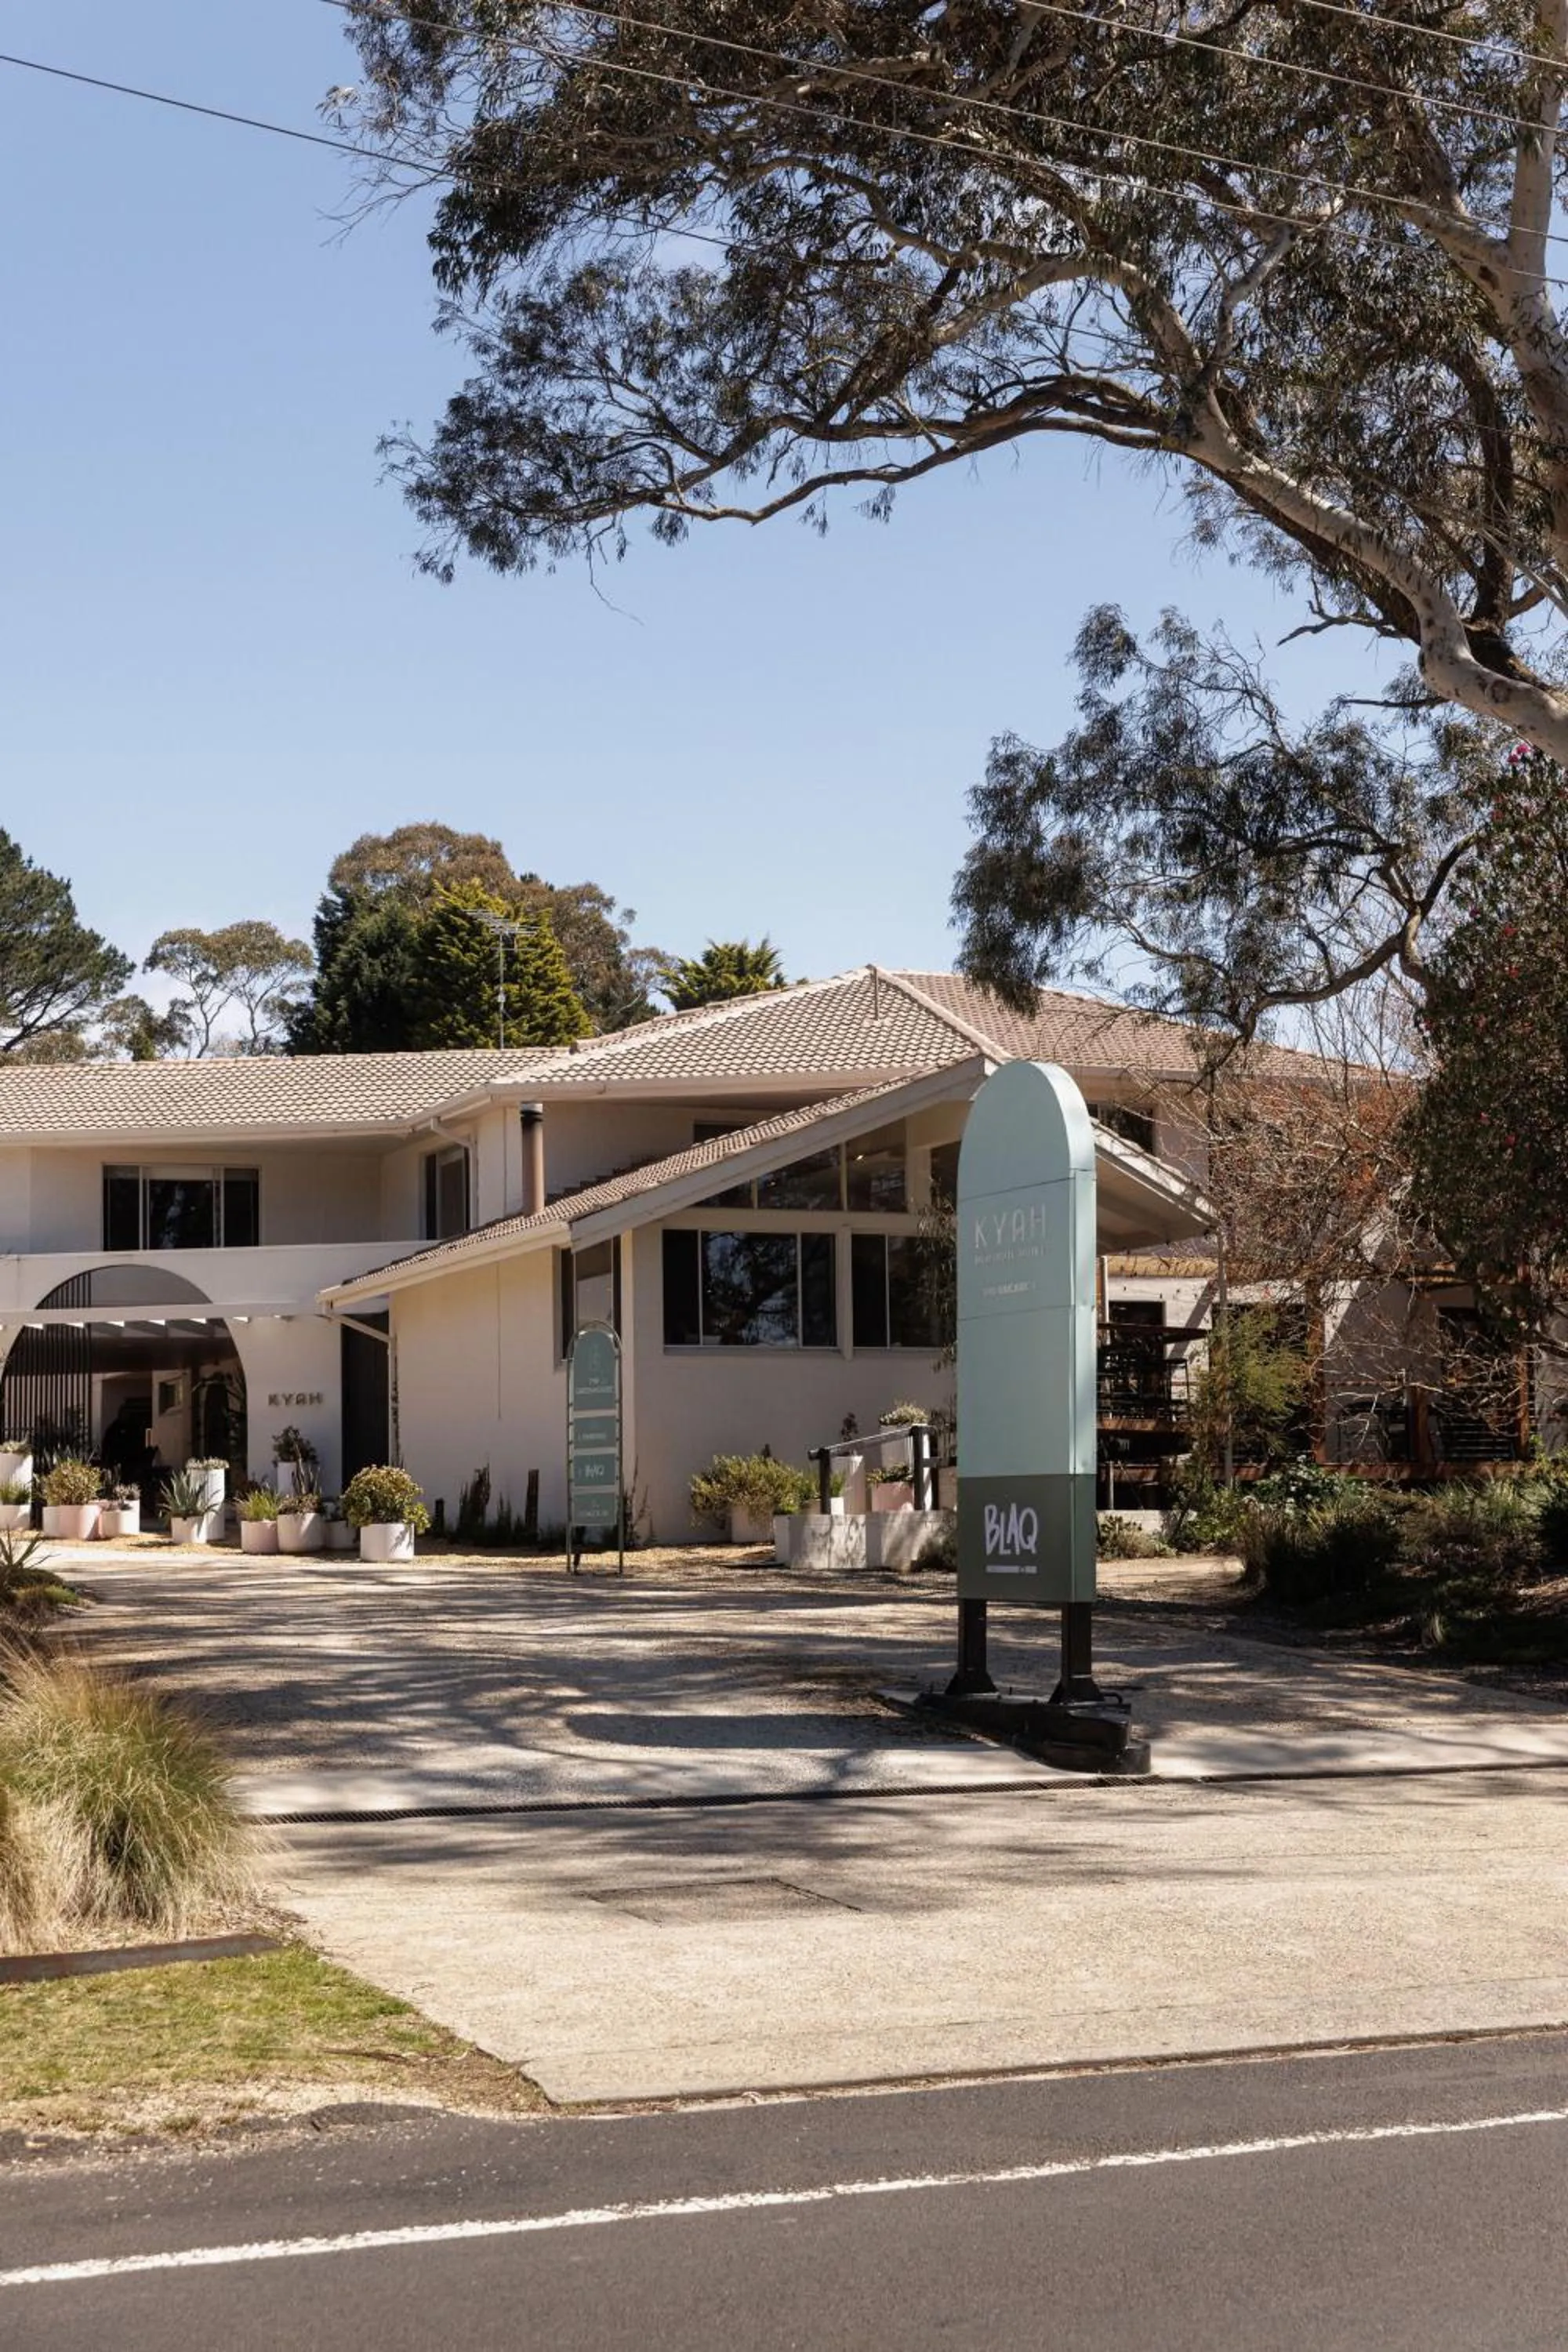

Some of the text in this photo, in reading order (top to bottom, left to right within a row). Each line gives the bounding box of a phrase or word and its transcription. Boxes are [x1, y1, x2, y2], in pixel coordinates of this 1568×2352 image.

[975, 1203, 1046, 1248] KYAH
[268, 1392, 323, 1406] KYAH
[984, 1503, 1038, 1555] BLAQ
